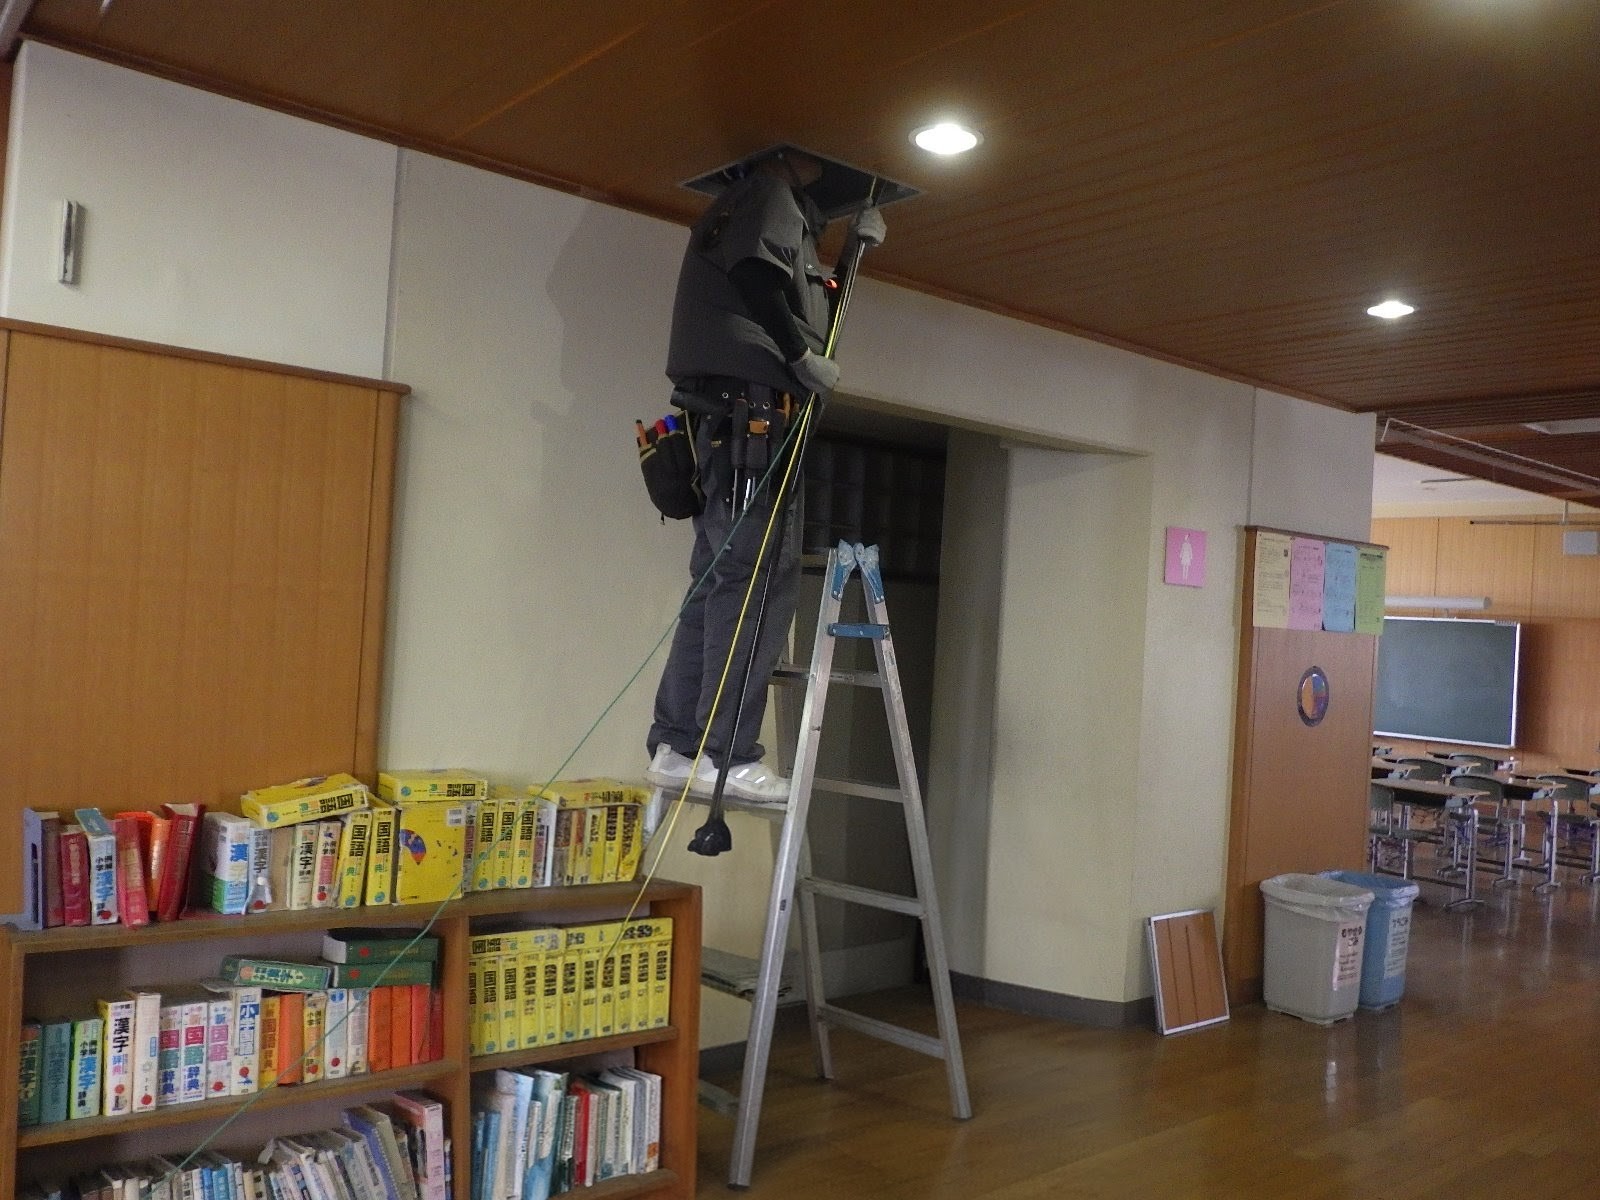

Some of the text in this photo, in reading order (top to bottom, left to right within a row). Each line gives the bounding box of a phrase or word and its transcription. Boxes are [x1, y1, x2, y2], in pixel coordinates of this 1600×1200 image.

[318, 793, 354, 814] 国語
[349, 824, 367, 857] 国語
[376, 822, 392, 854] 国語
[480, 812, 494, 842] 国語
[520, 810, 534, 840] 国語
[299, 841, 314, 870] 漢字
[484, 970, 497, 1004] 国語
[504, 968, 517, 1001] 国語
[112, 1017, 130, 1053] 漢字
